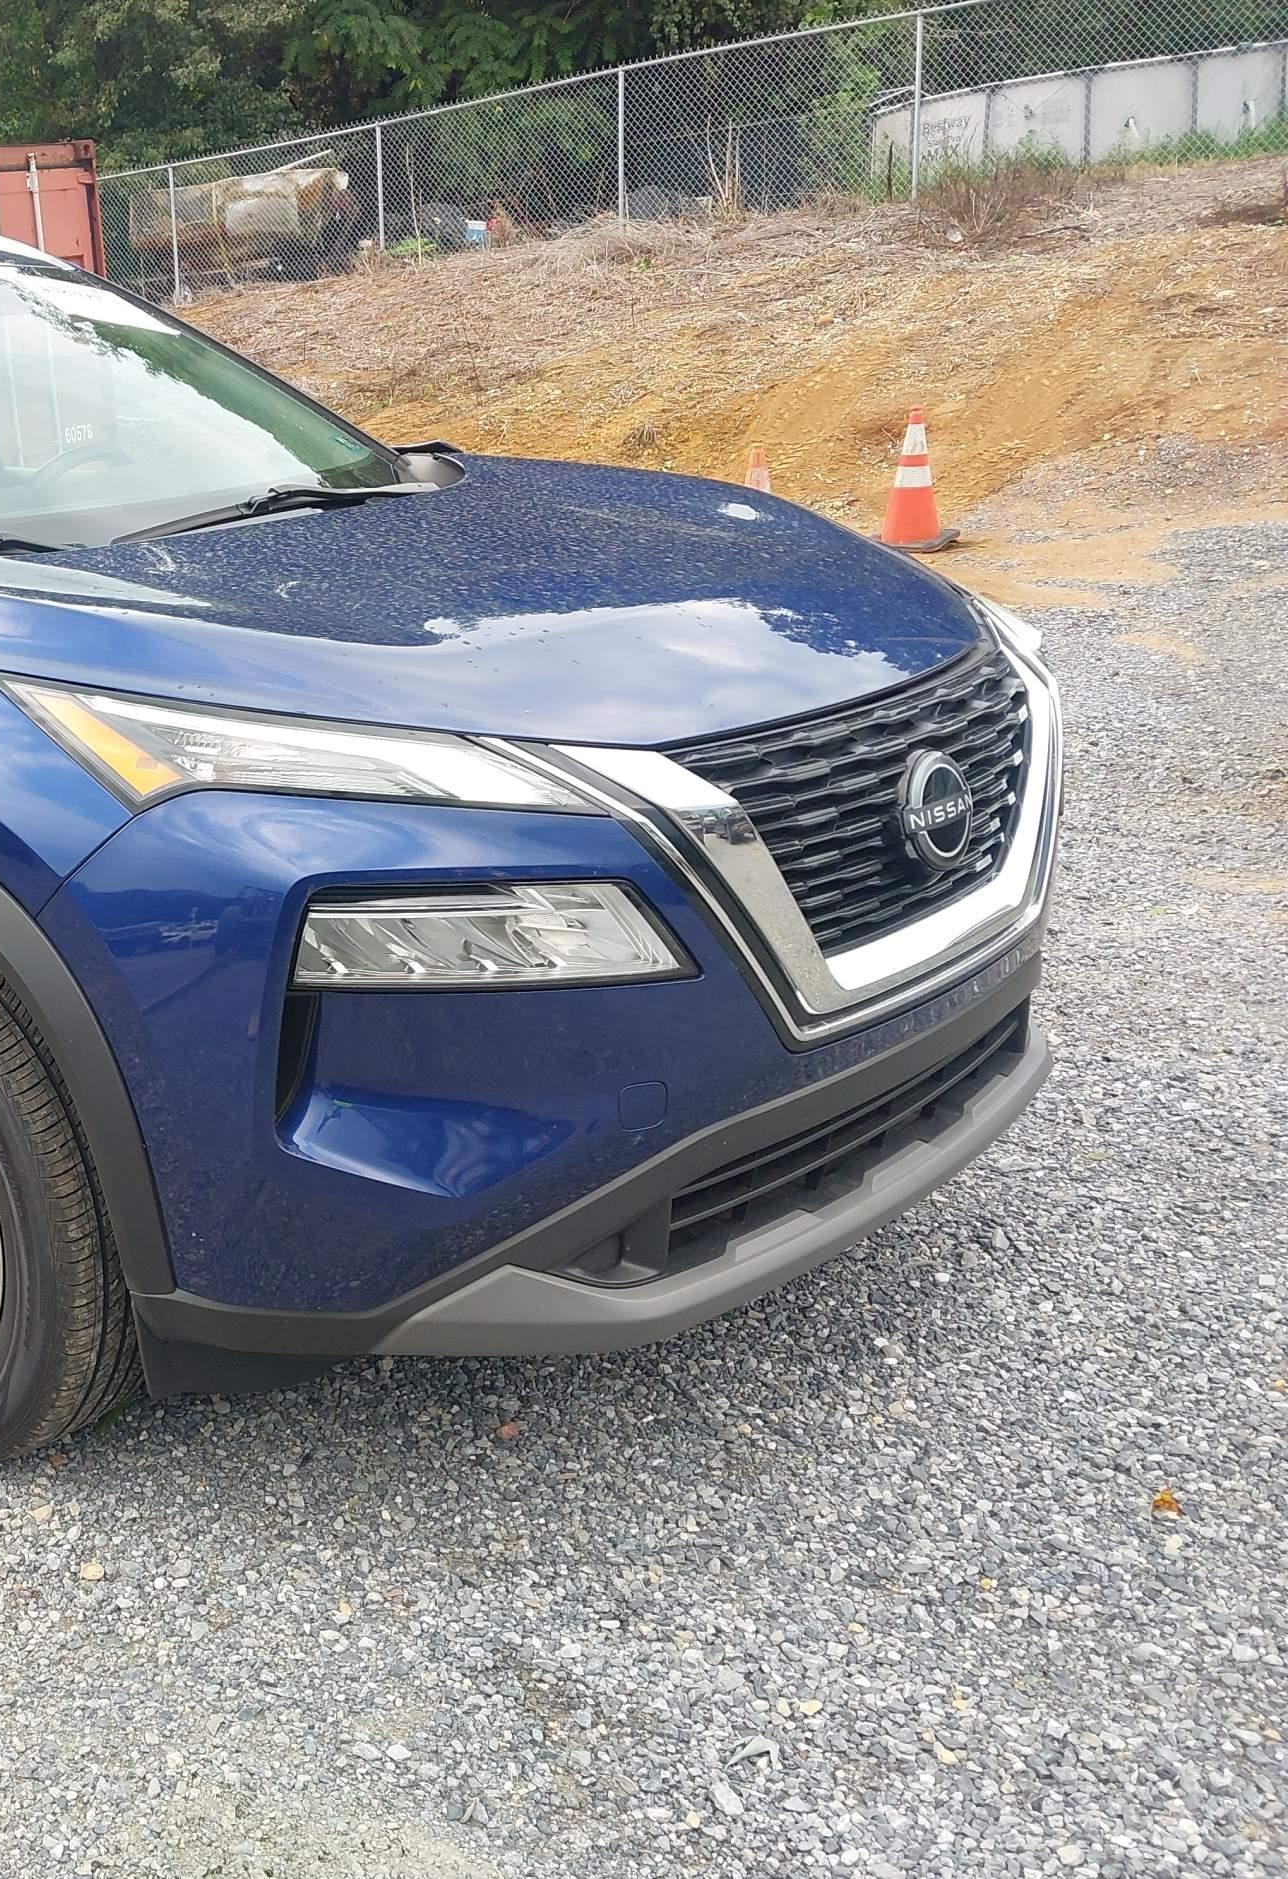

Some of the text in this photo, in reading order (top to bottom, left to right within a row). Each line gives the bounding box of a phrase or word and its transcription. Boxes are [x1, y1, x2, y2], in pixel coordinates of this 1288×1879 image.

[922, 117, 970, 135] Bestway
[64, 423, 94, 443] 60578
[909, 794, 972, 830] NISSAN
